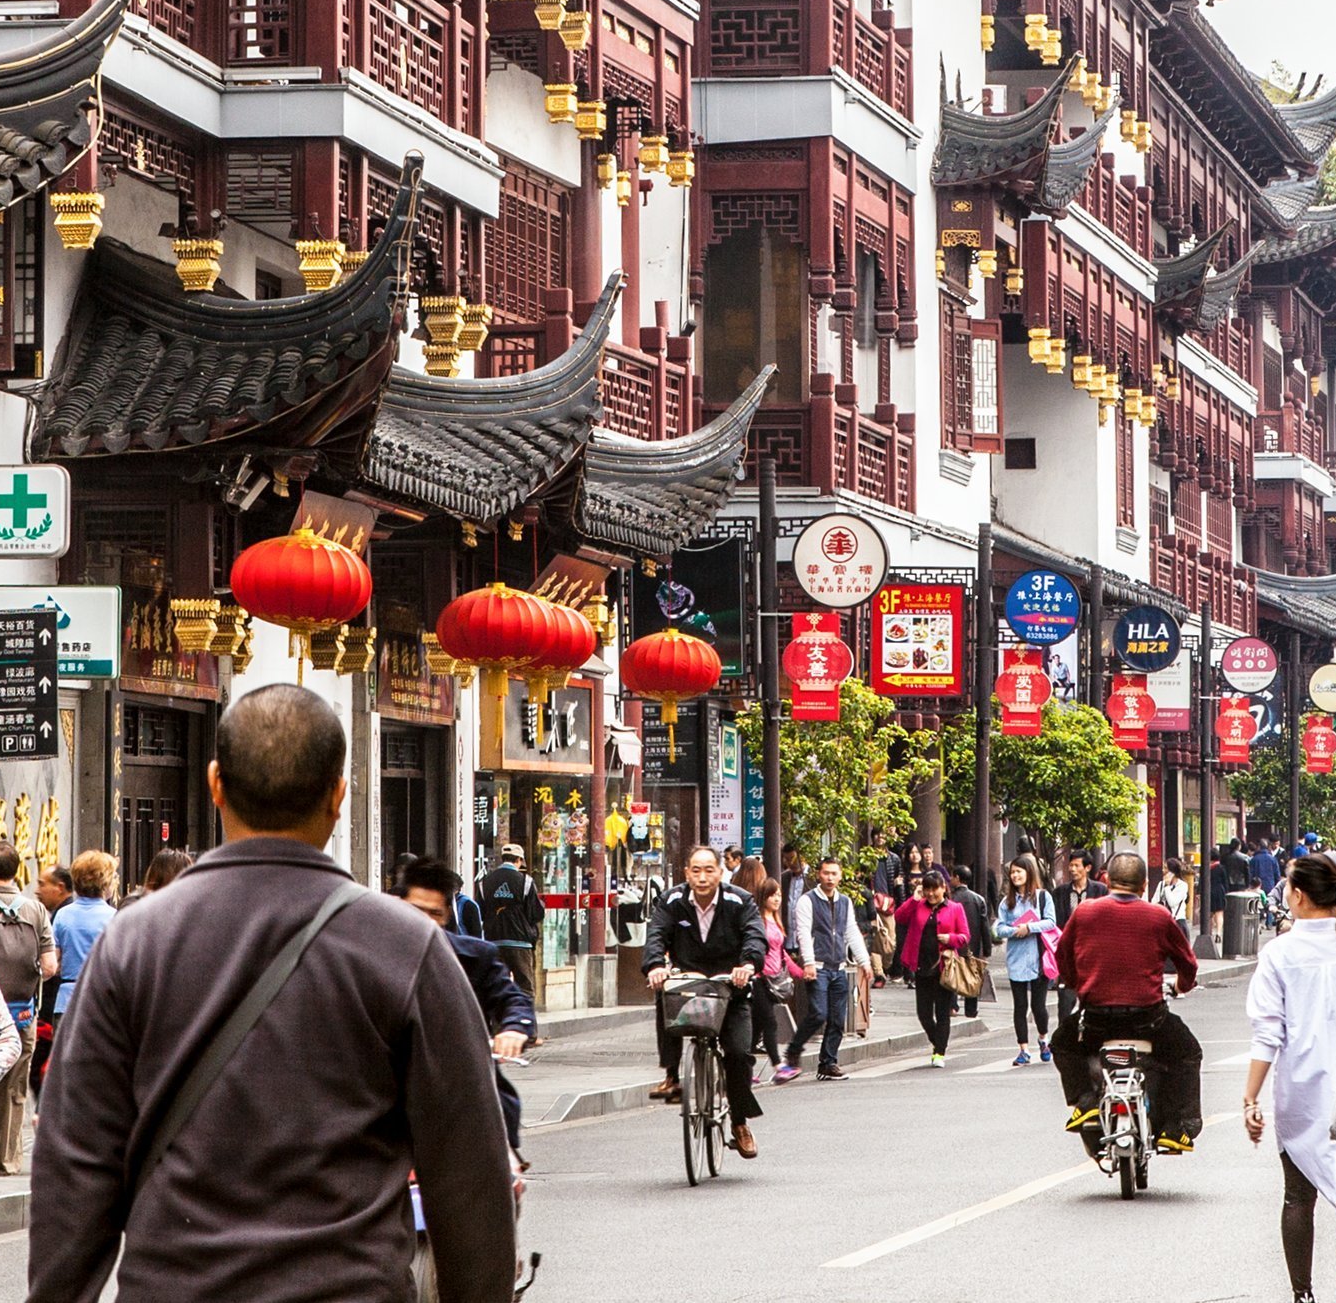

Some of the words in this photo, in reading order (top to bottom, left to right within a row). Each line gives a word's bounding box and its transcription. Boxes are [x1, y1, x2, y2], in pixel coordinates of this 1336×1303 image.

[1031, 575, 1056, 591] 3F
[879, 590, 901, 613] 3F
[1023, 602, 1061, 613] 欢迎光临
[1128, 623, 1170, 639] HLA
[57, 642, 91, 652] 售药店
[1126, 642, 1169, 654] 海澜之家
[807, 645, 828, 677] 友善
[1015, 675, 1032, 702] 爱国
[1123, 696, 1140, 719] 敬业
